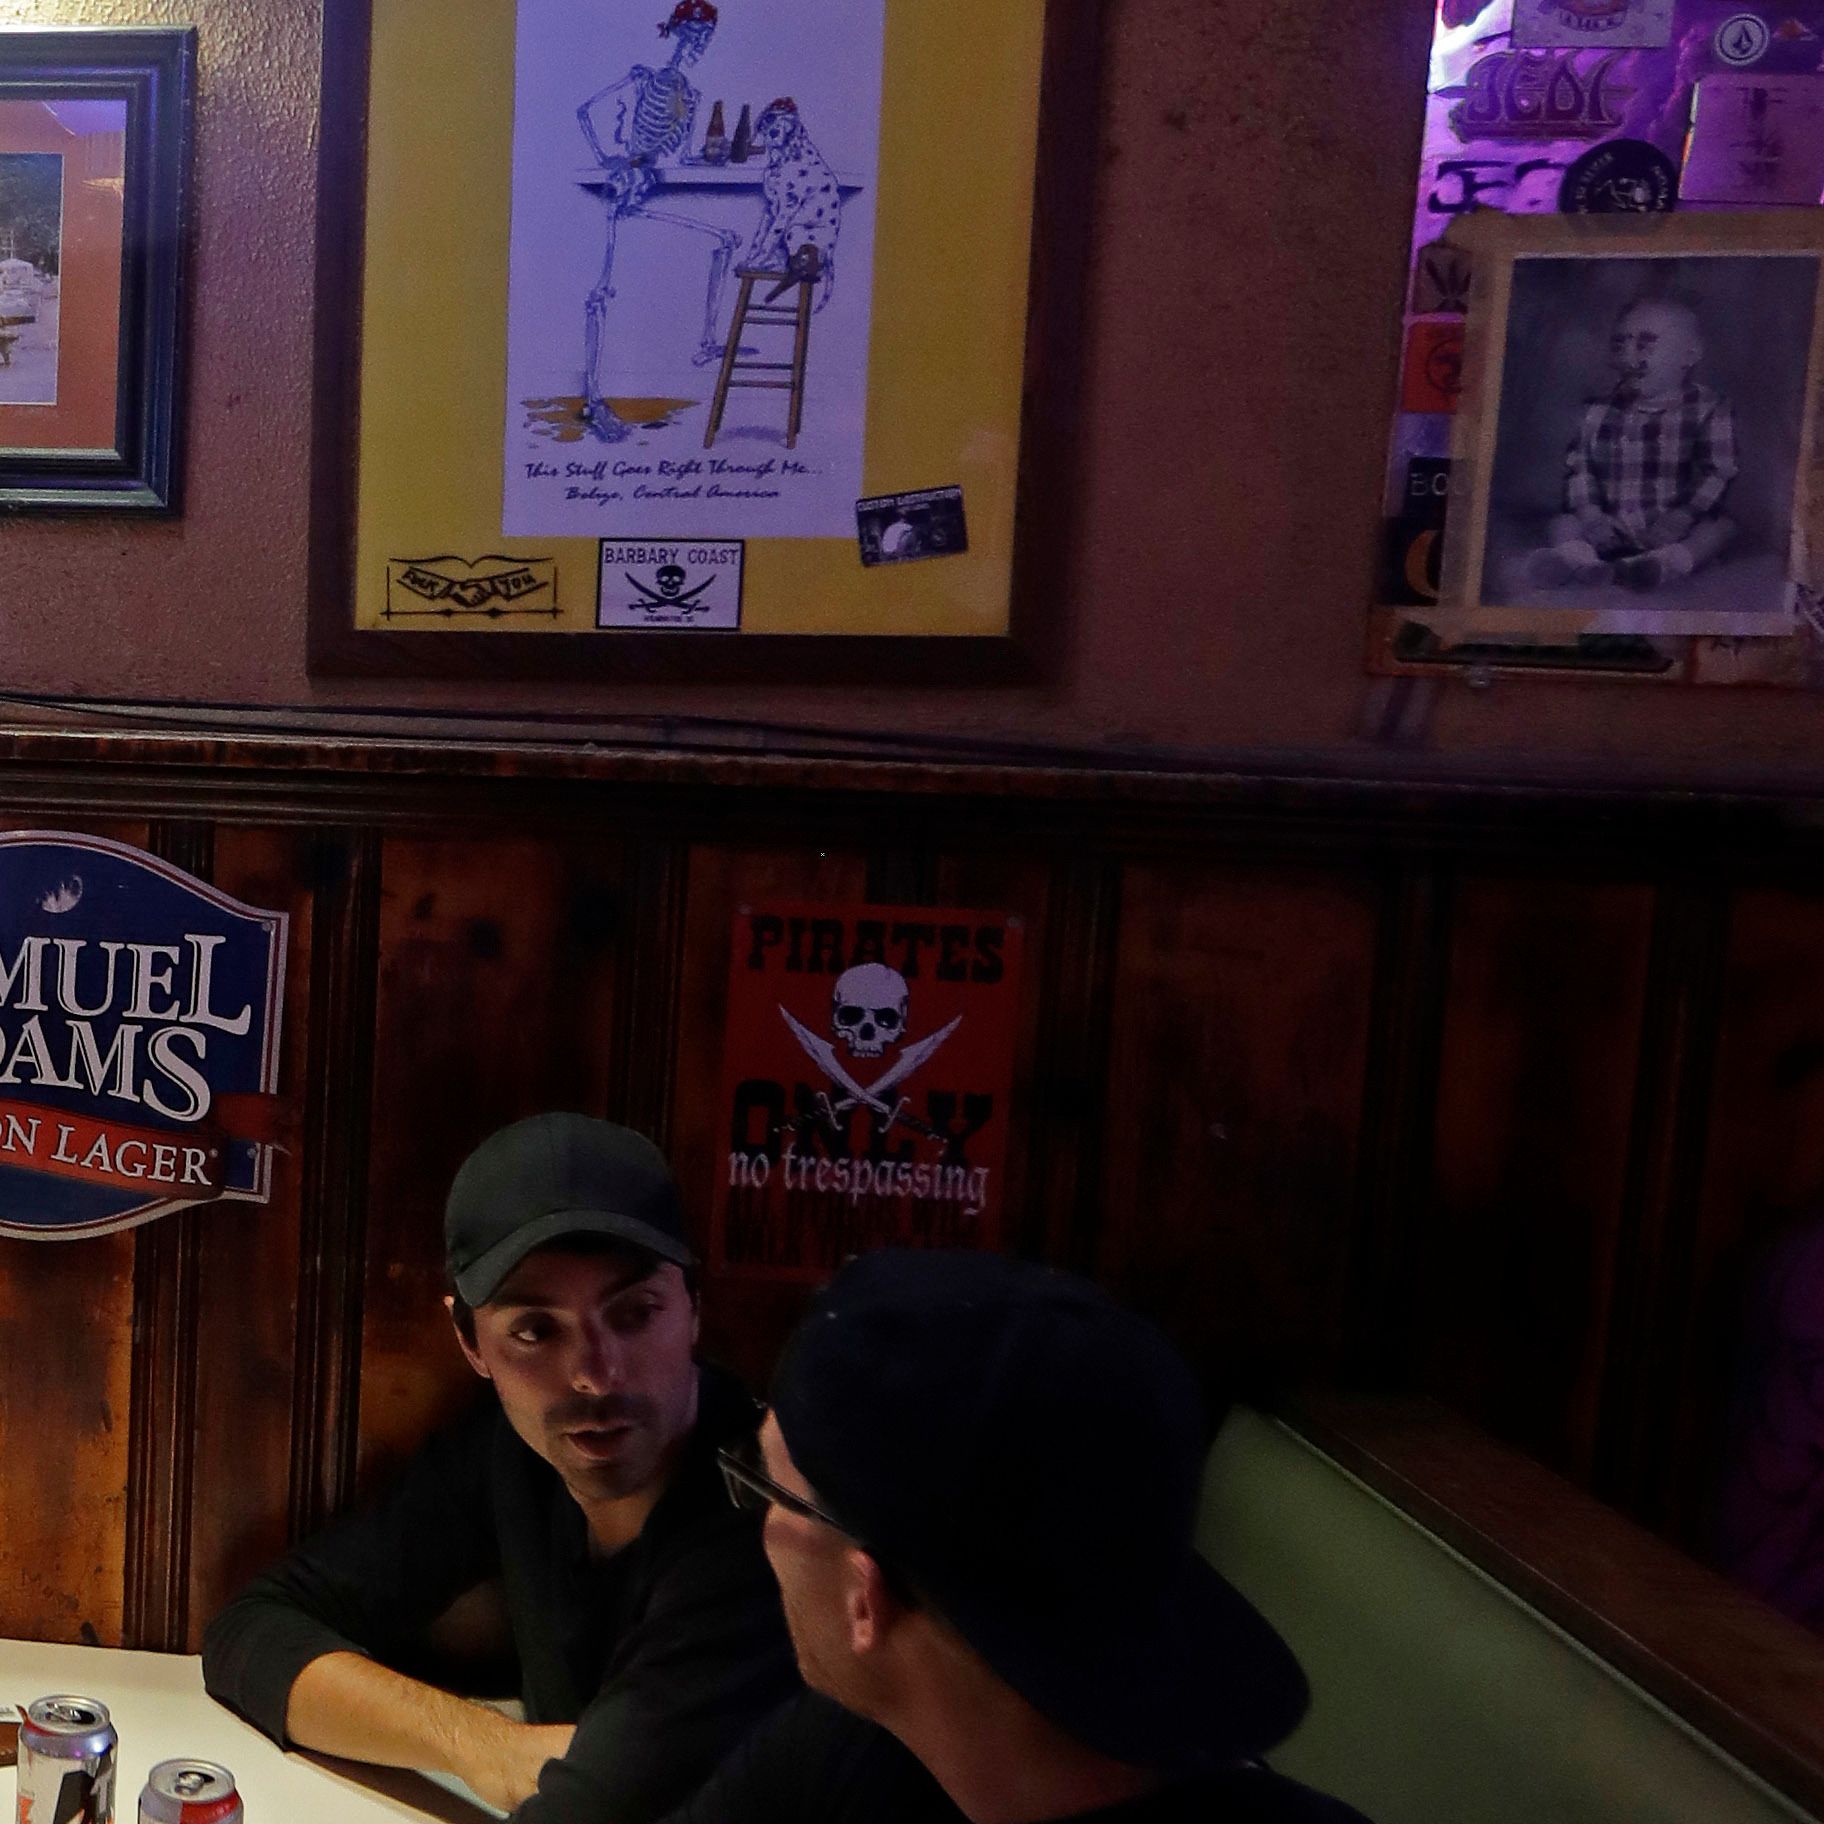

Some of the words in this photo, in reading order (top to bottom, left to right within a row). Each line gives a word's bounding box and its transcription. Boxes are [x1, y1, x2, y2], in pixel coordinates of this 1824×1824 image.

[525, 462, 558, 478] This
[565, 461, 608, 480] Stuff
[612, 461, 651, 477] Goes
[658, 460, 703, 480] Right
[708, 458, 776, 479] Through
[632, 484, 700, 500] Central
[706, 483, 780, 500] America
[603, 547, 679, 565] BARBARY
[687, 547, 740, 565] COAST
[747, 914, 1006, 984] PIRATES
[51, 1124, 212, 1186] LAGER
[727, 1150, 771, 1189] no
[781, 1142, 990, 1216] trespassing
